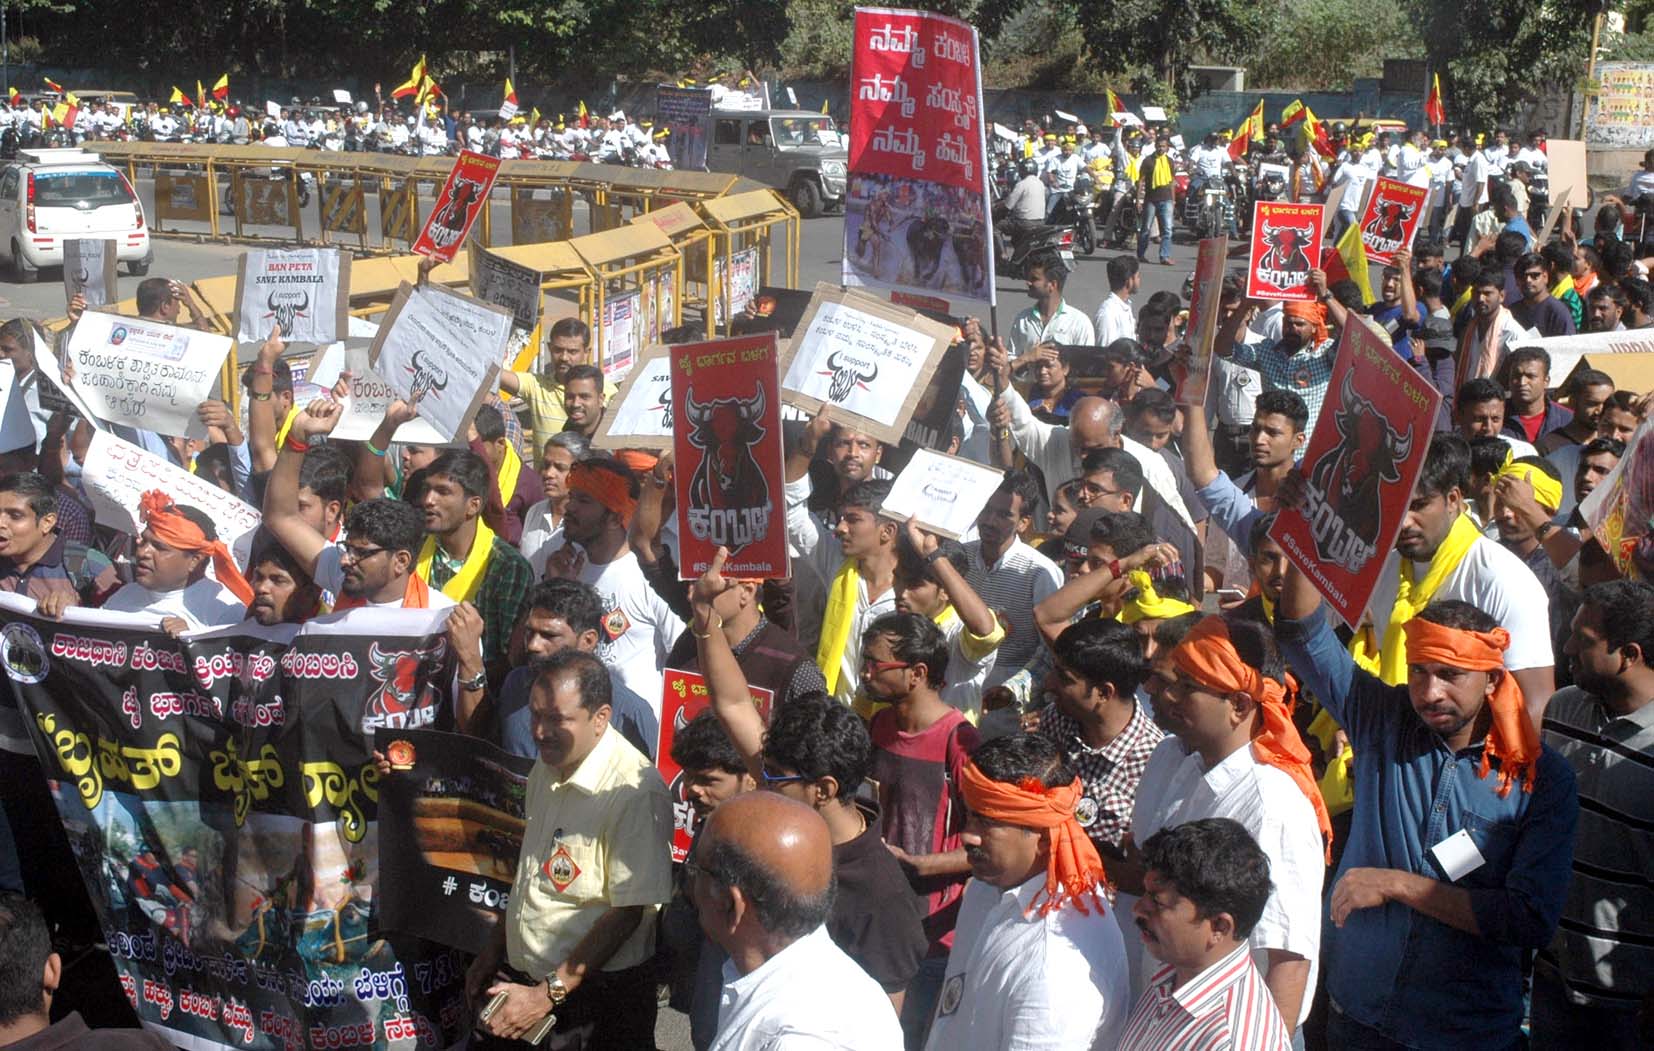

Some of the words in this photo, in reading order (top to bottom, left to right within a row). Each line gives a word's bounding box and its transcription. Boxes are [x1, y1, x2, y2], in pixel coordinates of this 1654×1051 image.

[869, 23, 926, 69] ನಮ್ಮ
[934, 30, 970, 67] ಕಂಬಳ
[859, 73, 916, 119] ನಮ್ಮ
[926, 81, 976, 130] ಸಂಸ್ಕೃತಿ
[872, 124, 926, 171] ನಮ್ಮ
[936, 132, 973, 181] ಹೆಮ್ಮೆ
[256, 275, 277, 284] SAVE
[278, 275, 324, 283] KAMBALA
[268, 263, 287, 272] BAN
[288, 263, 313, 271] PETA
[843, 354, 871, 370] support
[1282, 532, 1349, 609] #SaveKambala
[52, 633, 127, 668] ರಾಜಧಾನಿ
[131, 640, 187, 674] ಕಂಬಳ
[123, 685, 142, 729] ಜೈ
[672, 678, 687, 699] ಜೈ
[210, 735, 285, 828] ಬೈಕ್
[353, 961, 411, 1013] ಬೆಳಿಗ್ಗೆ
